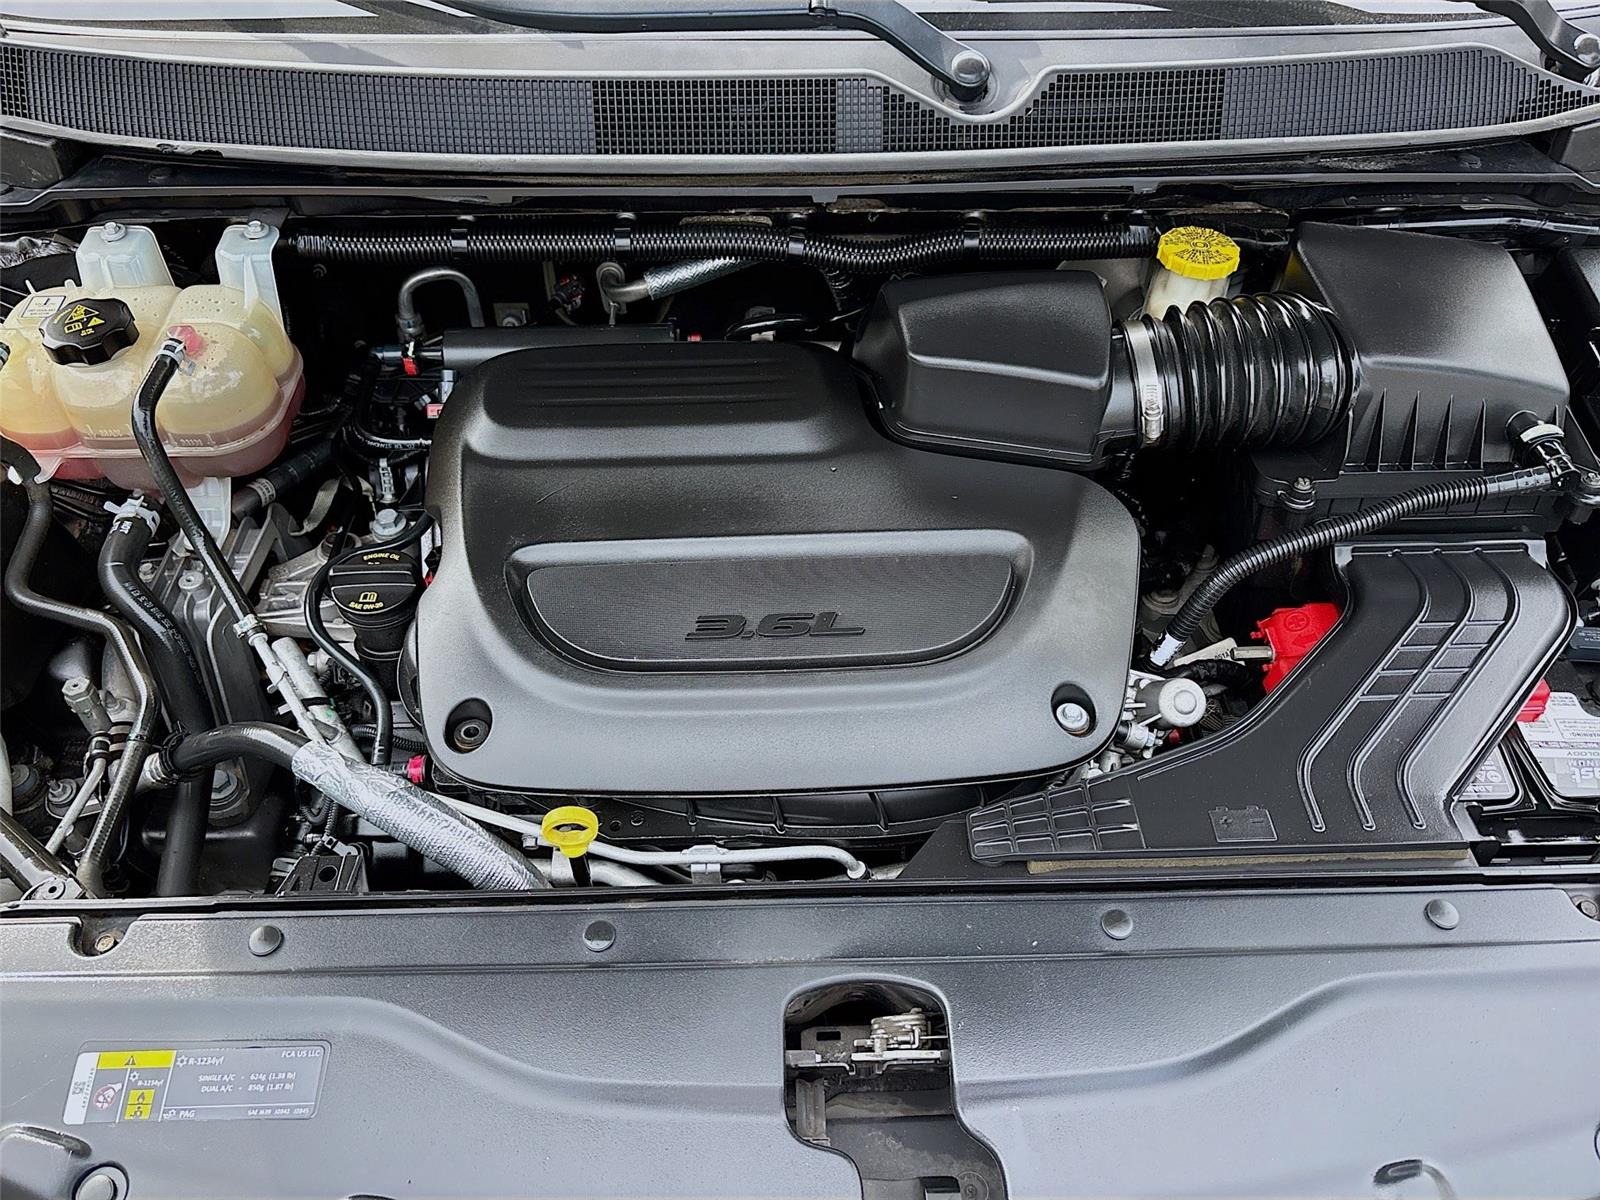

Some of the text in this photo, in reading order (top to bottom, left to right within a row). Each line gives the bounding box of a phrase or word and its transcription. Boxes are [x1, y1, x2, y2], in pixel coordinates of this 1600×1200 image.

[363, 552, 400, 561] ENGINE OIL
[348, 601, 363, 609] SAE
[685, 611, 866, 641] 3.6L
[281, 1049, 321, 1058] FCA US LLC
[188, 1056, 225, 1066] R-1234yf
[198, 1074, 222, 1082] SINGLE
[222, 1073, 236, 1083] A/C
[201, 1085, 220, 1093] DUAL
[220, 1084, 234, 1093] A/C
[178, 1109, 196, 1119] PAG
